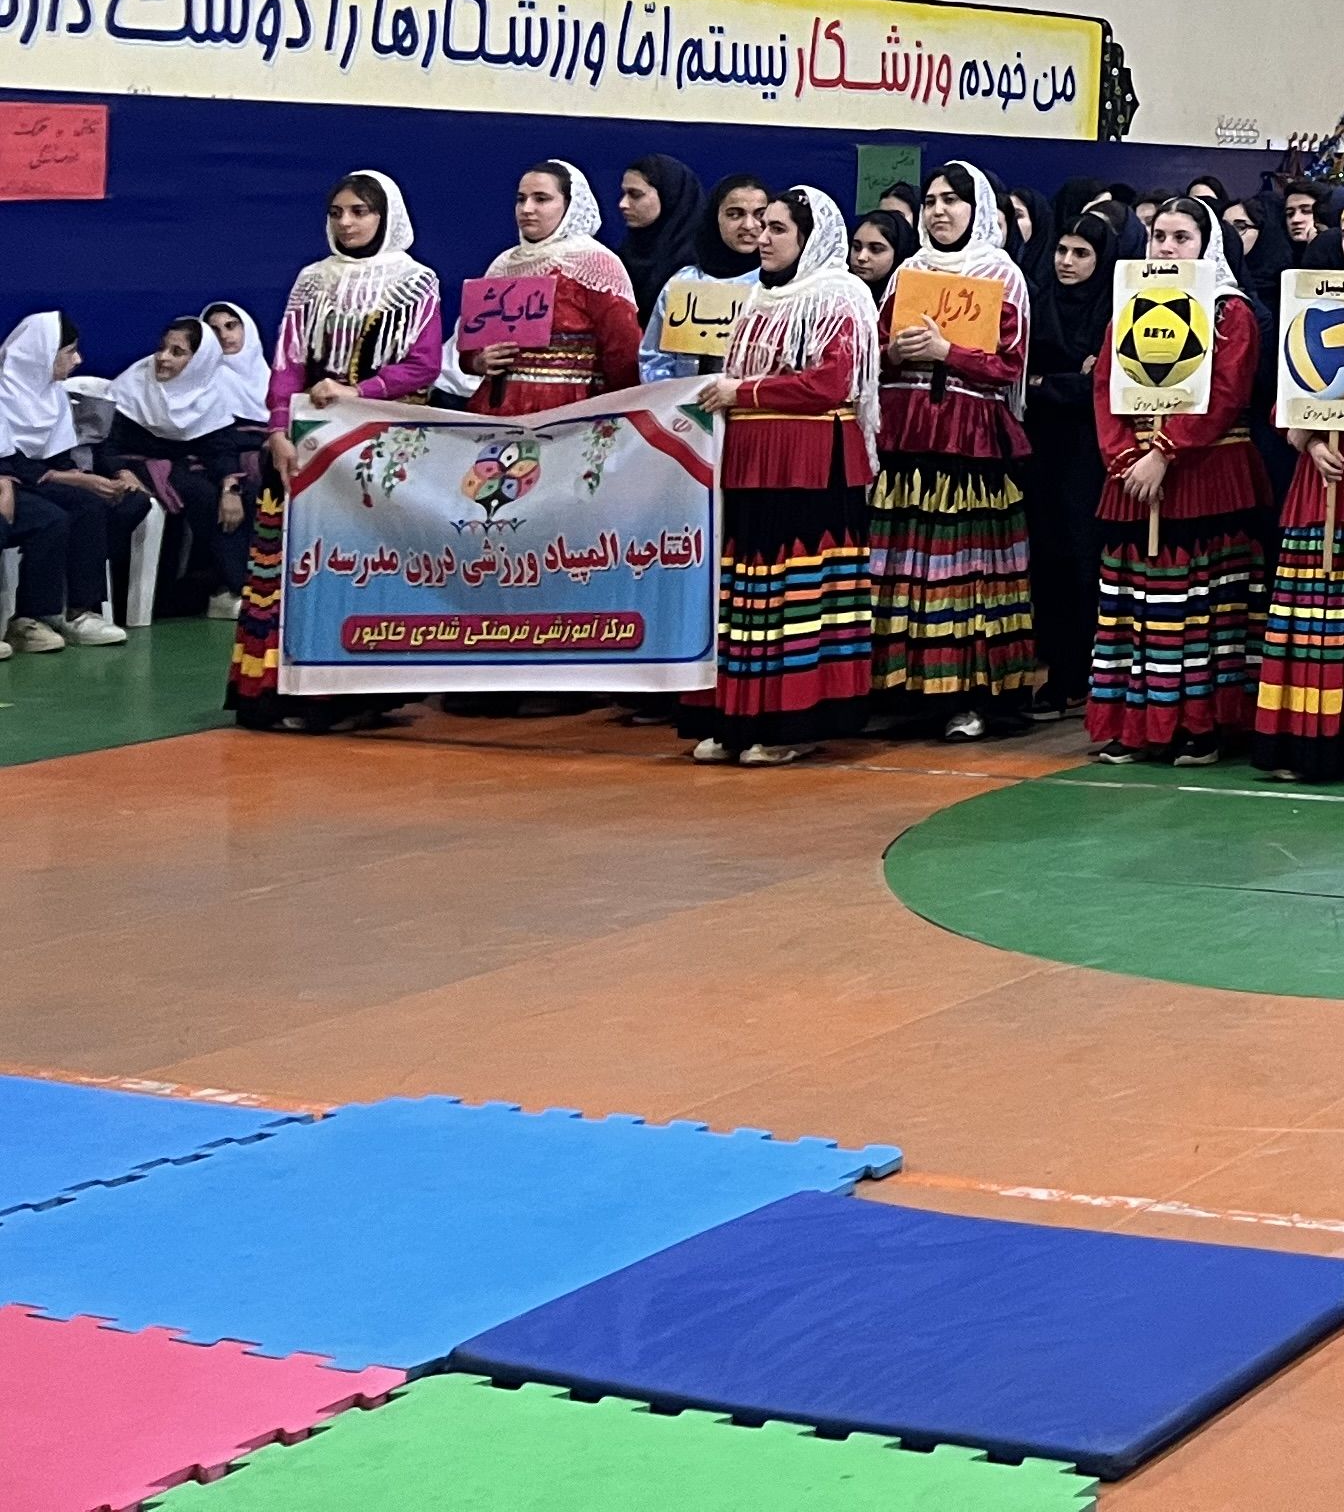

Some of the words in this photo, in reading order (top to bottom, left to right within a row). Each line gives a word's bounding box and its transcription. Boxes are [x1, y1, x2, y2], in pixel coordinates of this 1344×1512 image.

[677, 25, 787, 100] نیستم
[795, 17, 953, 107] ورزشکار
[959, 52, 1027, 111] خودم
[1033, 65, 1076, 111] من
[1142, 263, 1179, 279] هندبال
[669, 291, 743, 338] الیبال
[1143, 327, 1176, 339] BETA
[291, 538, 321, 585] ای
[328, 545, 399, 585] مدرسه
[406, 546, 455, 584] درون
[462, 539, 538, 585] ورزشی
[546, 532, 618, 583] المپیاد
[626, 523, 702, 577] افتتاحیه
[352, 621, 406, 650] خاکپور
[411, 616, 460, 645] شادی
[533, 615, 600, 644] آموزشی
[600, 618, 635, 641] مرکز
